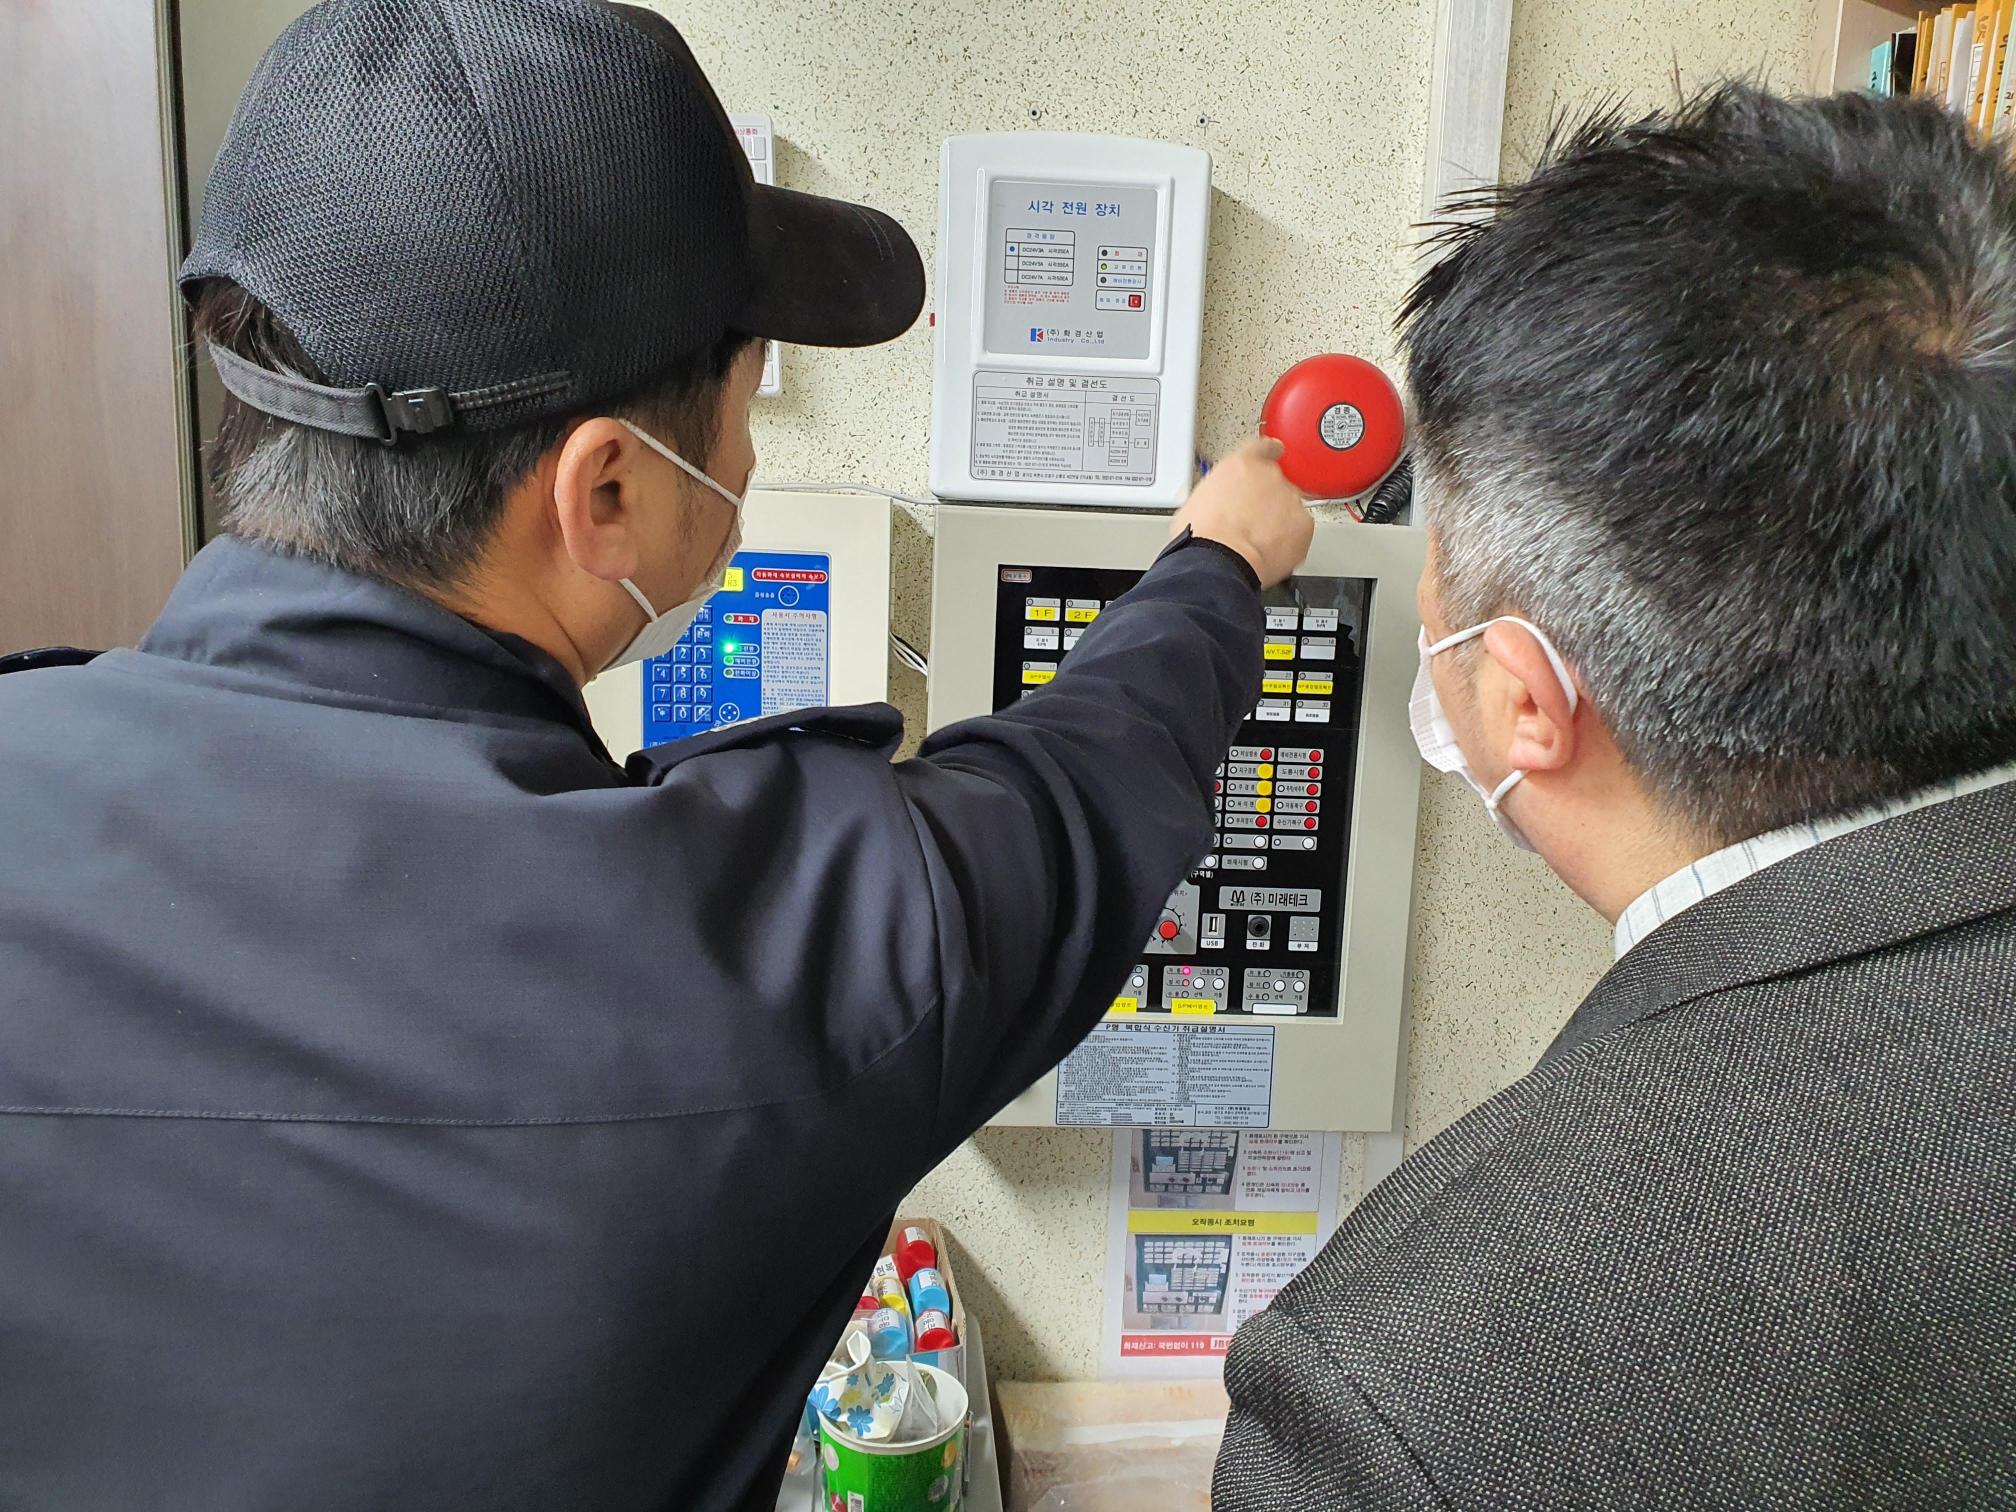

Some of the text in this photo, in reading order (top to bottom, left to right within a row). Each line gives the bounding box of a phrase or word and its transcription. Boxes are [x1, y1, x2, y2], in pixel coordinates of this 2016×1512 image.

[1028, 200, 1120, 217] 시각 전원 장치
[1025, 376, 1109, 389] 취급 설명 및 결선도
[1250, 892, 1265, 906] (주)
[1268, 892, 1309, 907] 미래테크
[1153, 1025, 1180, 1033] 수신기
[1191, 1218, 1256, 1227] 오작동시 조치요령
